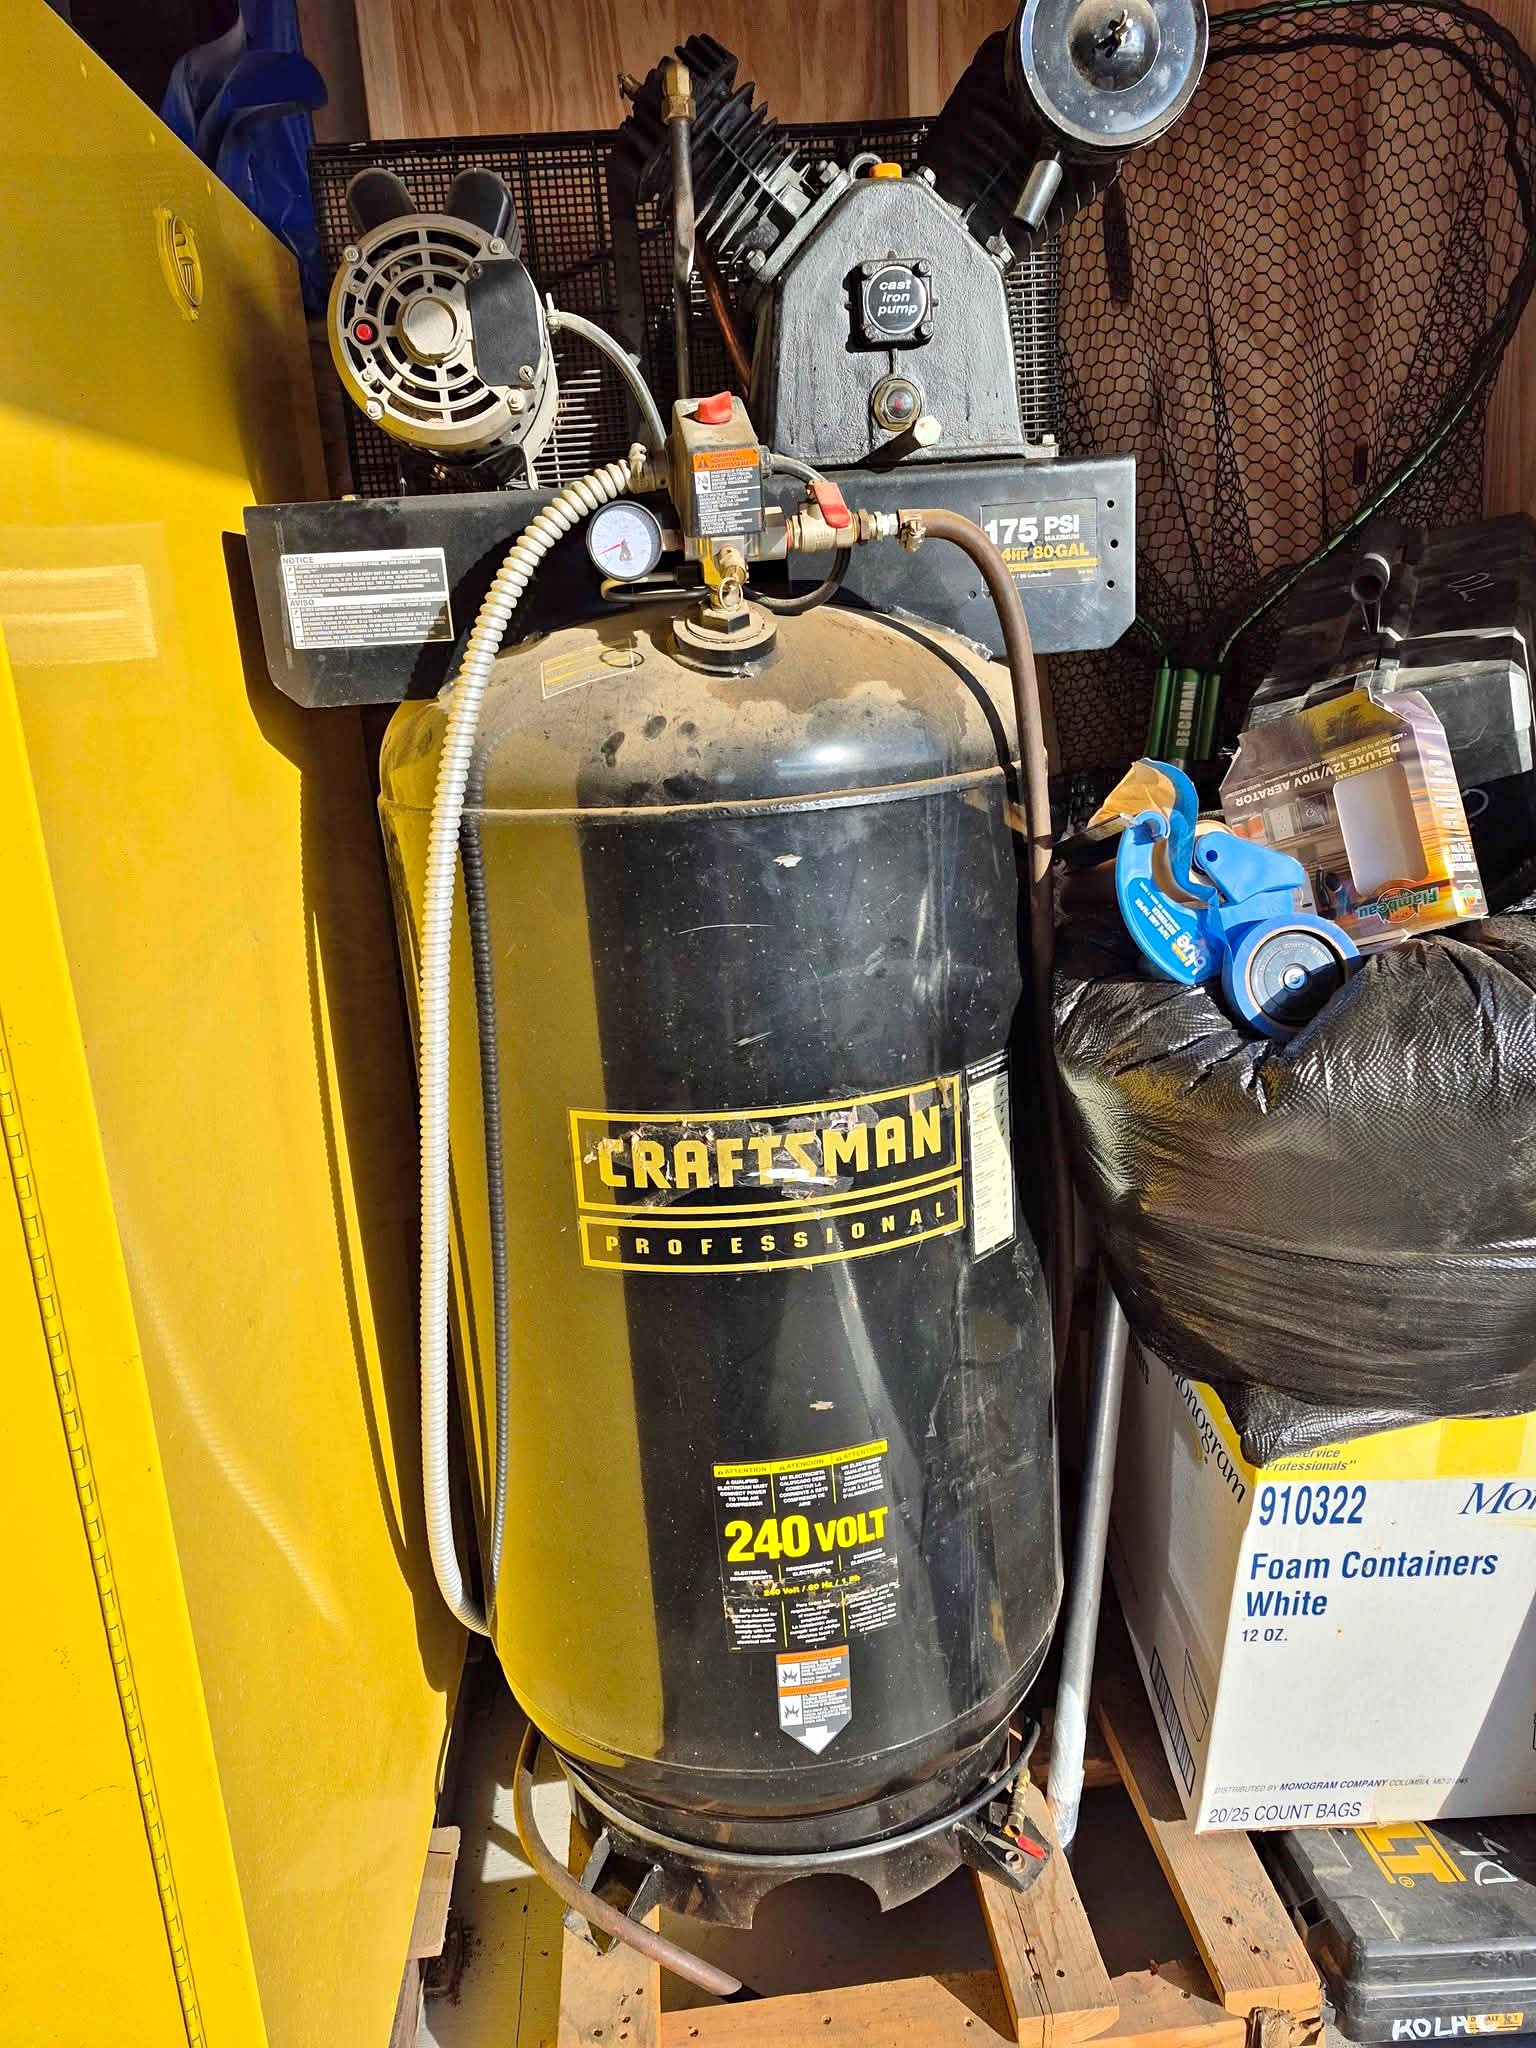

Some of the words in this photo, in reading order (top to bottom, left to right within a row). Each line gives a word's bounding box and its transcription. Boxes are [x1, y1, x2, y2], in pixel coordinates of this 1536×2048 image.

[879, 280, 911, 290] cast
[882, 292, 910, 303] iron
[877, 304, 918, 317] pump
[984, 517, 1039, 545] 175
[1044, 514, 1080, 535] PSI
[1044, 534, 1080, 542] MAXIMUM
[283, 556, 315, 565] NOTICE
[1176, 682, 1197, 746] BECKMAN
[1348, 742, 1401, 768] DELUXE
[1294, 762, 1347, 788] 12V/110V
[1235, 781, 1290, 806] AERATOR
[1358, 887, 1439, 919] Flambeau
[1176, 932, 1206, 975] blue
[598, 1105, 943, 1189] CRAFTSMAN
[605, 1202, 945, 1255] PROFESSIONAL
[843, 1446, 882, 1458] ATTENTION
[1175, 1374, 1246, 1504] onogram
[1296, 1447, 1341, 1458] ervice
[1259, 1485, 1366, 1526] 910322
[725, 1515, 811, 1562] 240
[814, 1506, 888, 1552] VOLT
[1250, 1553, 1331, 1580] Foam
[1342, 1550, 1498, 1579] Containers
[763, 1588, 781, 1597] 240
[782, 1586, 800, 1595] Volt
[807, 1583, 820, 1591] 60
[1247, 1591, 1328, 1617] White
[1241, 1629, 1259, 1642] 12
[1264, 1628, 1288, 1642] OZ.
[1215, 1785, 1266, 1794] DISTRIBUTED
[1266, 1784, 1278, 1792] BY
[1280, 1781, 1339, 1791] MONOGRAM
[1339, 1779, 1388, 1788] COMPANY
[1208, 1807, 1249, 1823] 20/25
[1254, 1803, 1313, 1821] COUNT
[1316, 1802, 1361, 1818] BAGS
